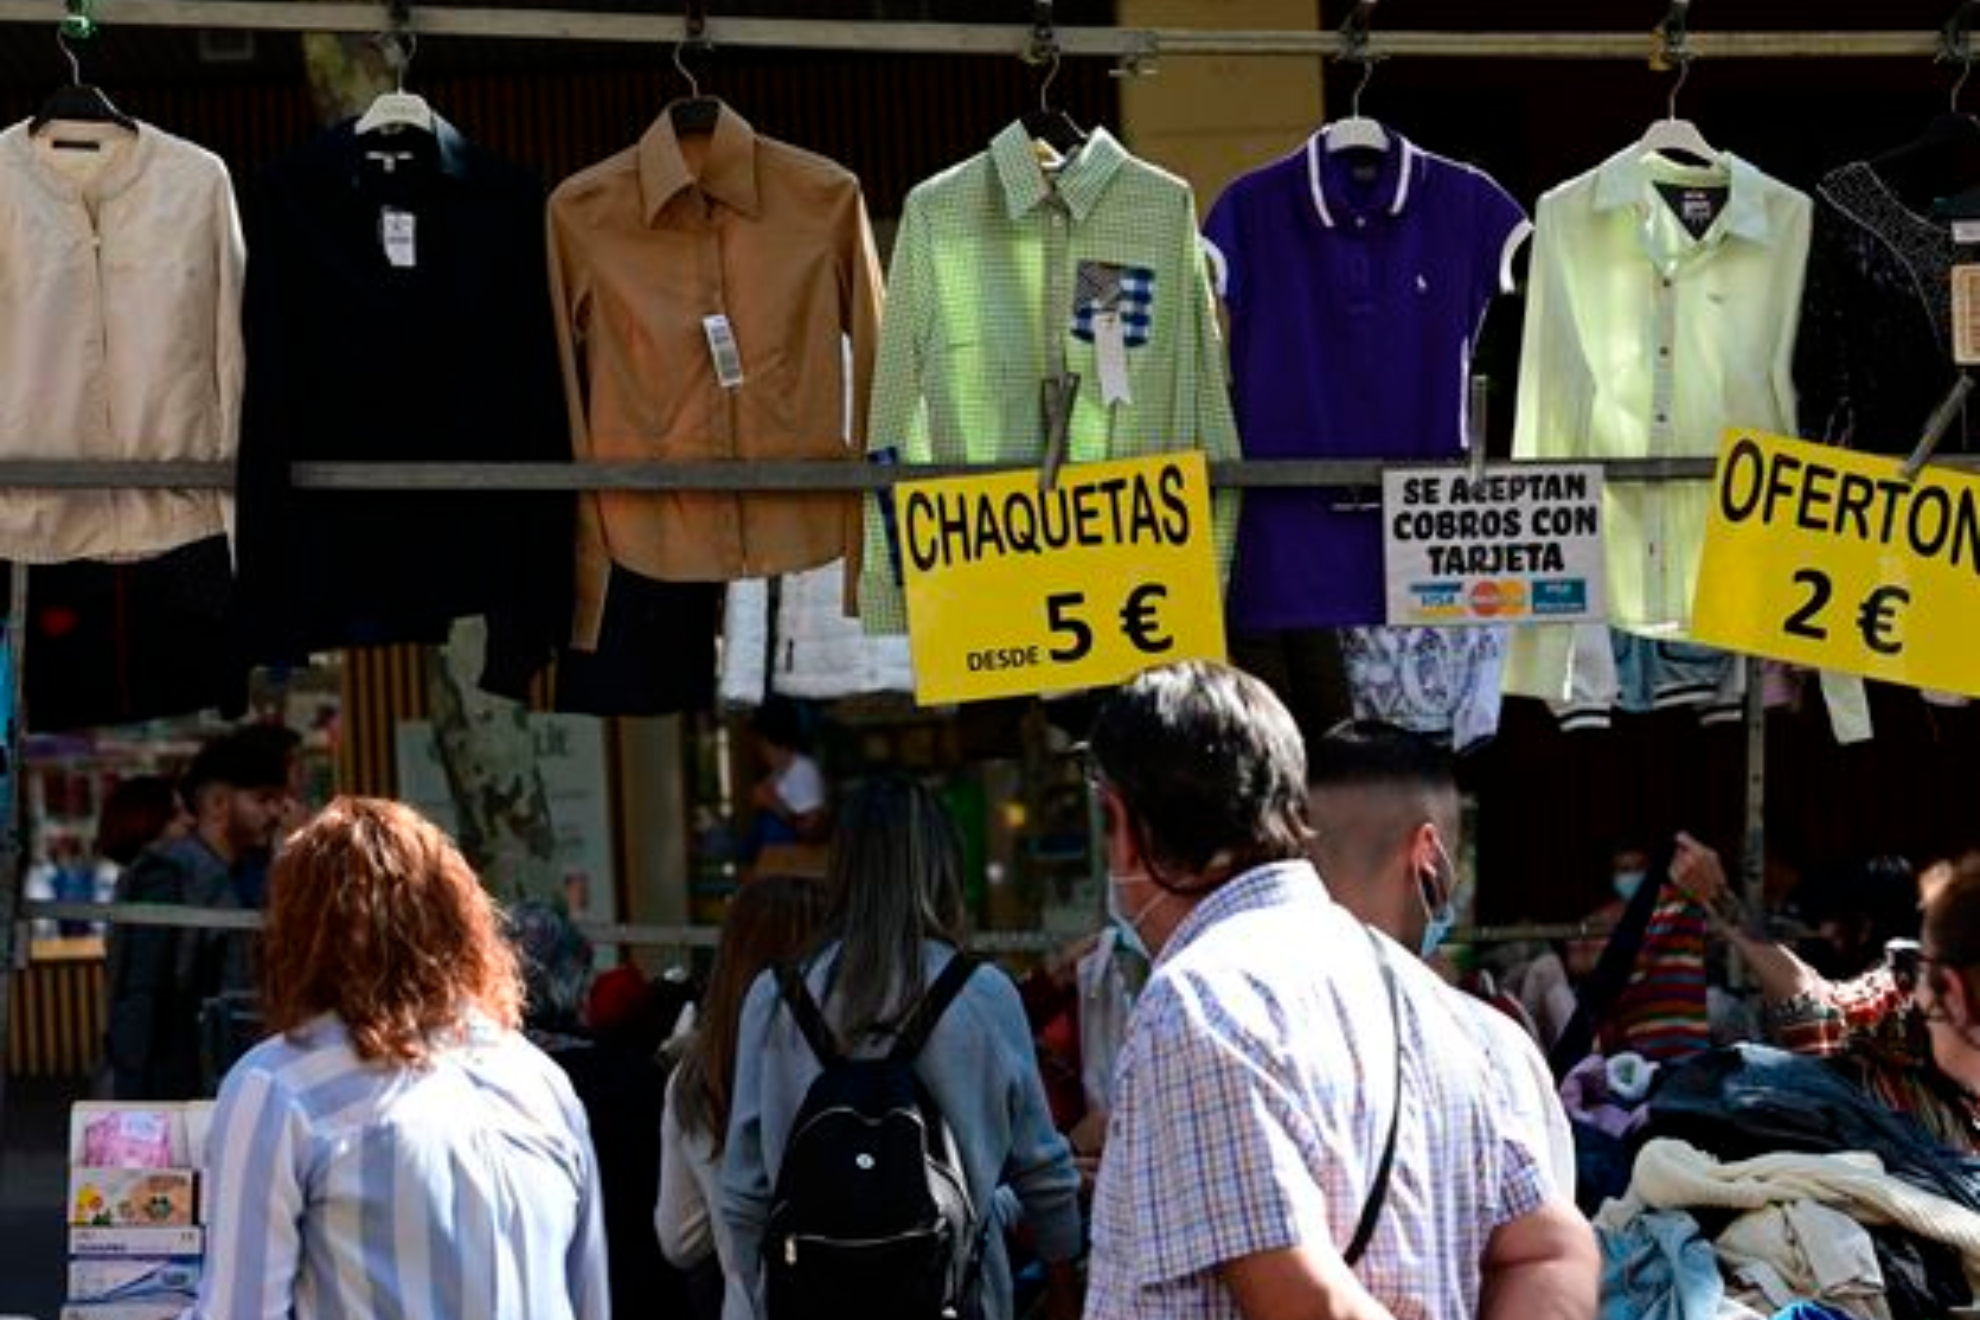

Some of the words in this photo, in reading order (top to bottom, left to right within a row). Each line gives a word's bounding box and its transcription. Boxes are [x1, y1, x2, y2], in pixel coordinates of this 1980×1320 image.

[906, 464, 1189, 571] CHAQUETAS
[1403, 478, 1440, 504] SE
[1393, 508, 1521, 540] COBROS
[1531, 506, 1597, 536] CON
[1427, 542, 1564, 575] TARJETA
[967, 646, 1038, 671] DESDE
[1046, 592, 1092, 662] 5
[1119, 584, 1173, 653] €
[1784, 568, 1831, 639] 2
[1857, 586, 1909, 654] €
